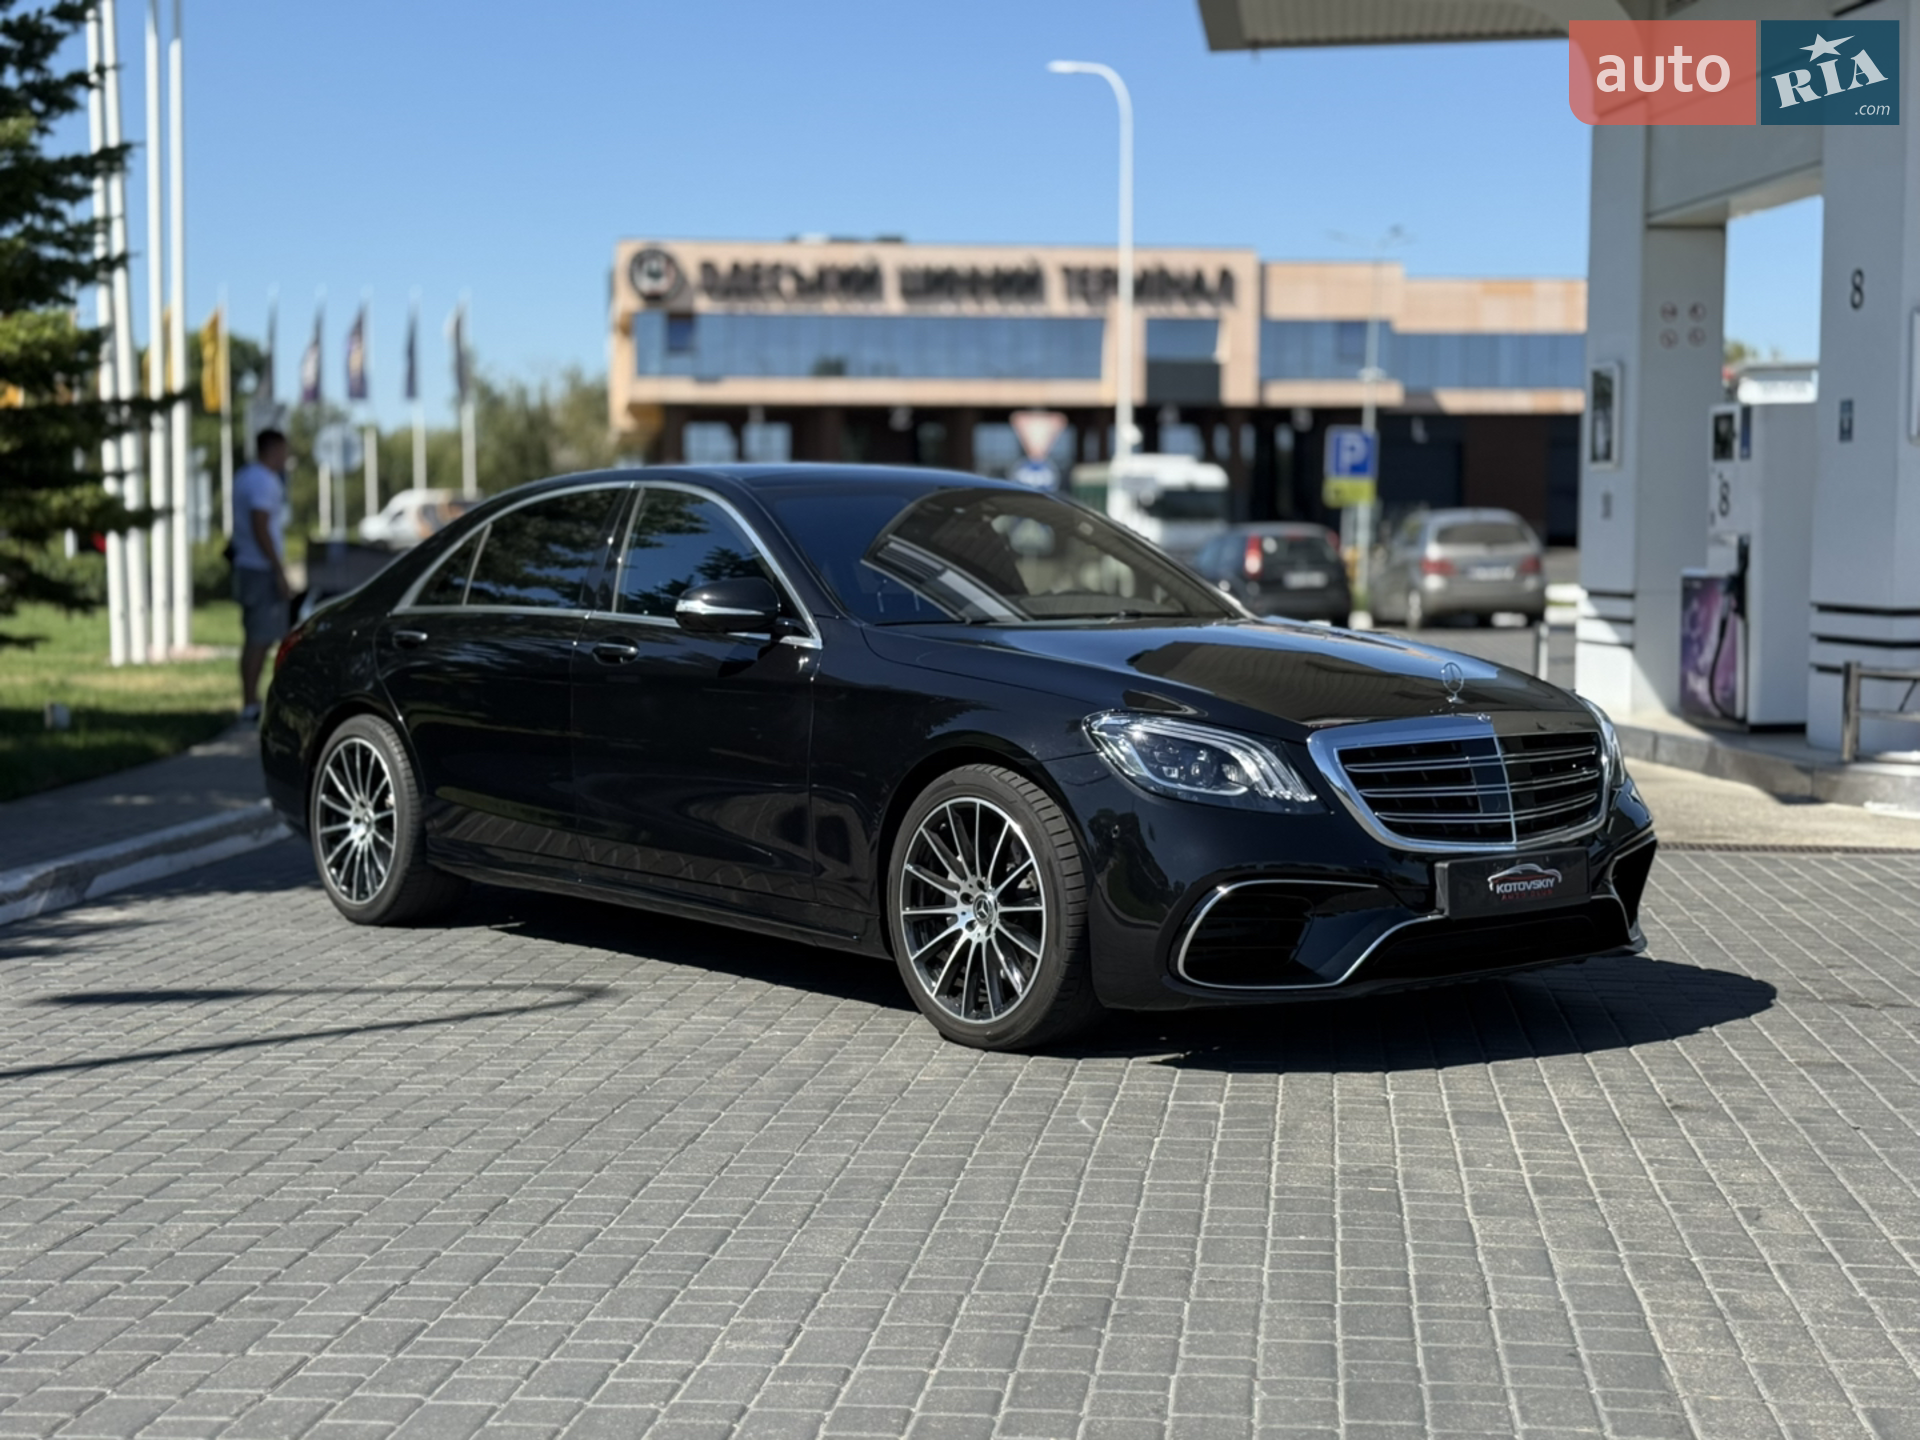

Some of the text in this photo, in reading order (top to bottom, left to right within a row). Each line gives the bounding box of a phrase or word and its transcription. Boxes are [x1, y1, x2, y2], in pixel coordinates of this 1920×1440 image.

[1850, 267, 1865, 311] 8
[1340, 432, 1366, 474] P
[1718, 480, 1731, 518] 8
[1496, 878, 1555, 894] KOTOVSKIY
